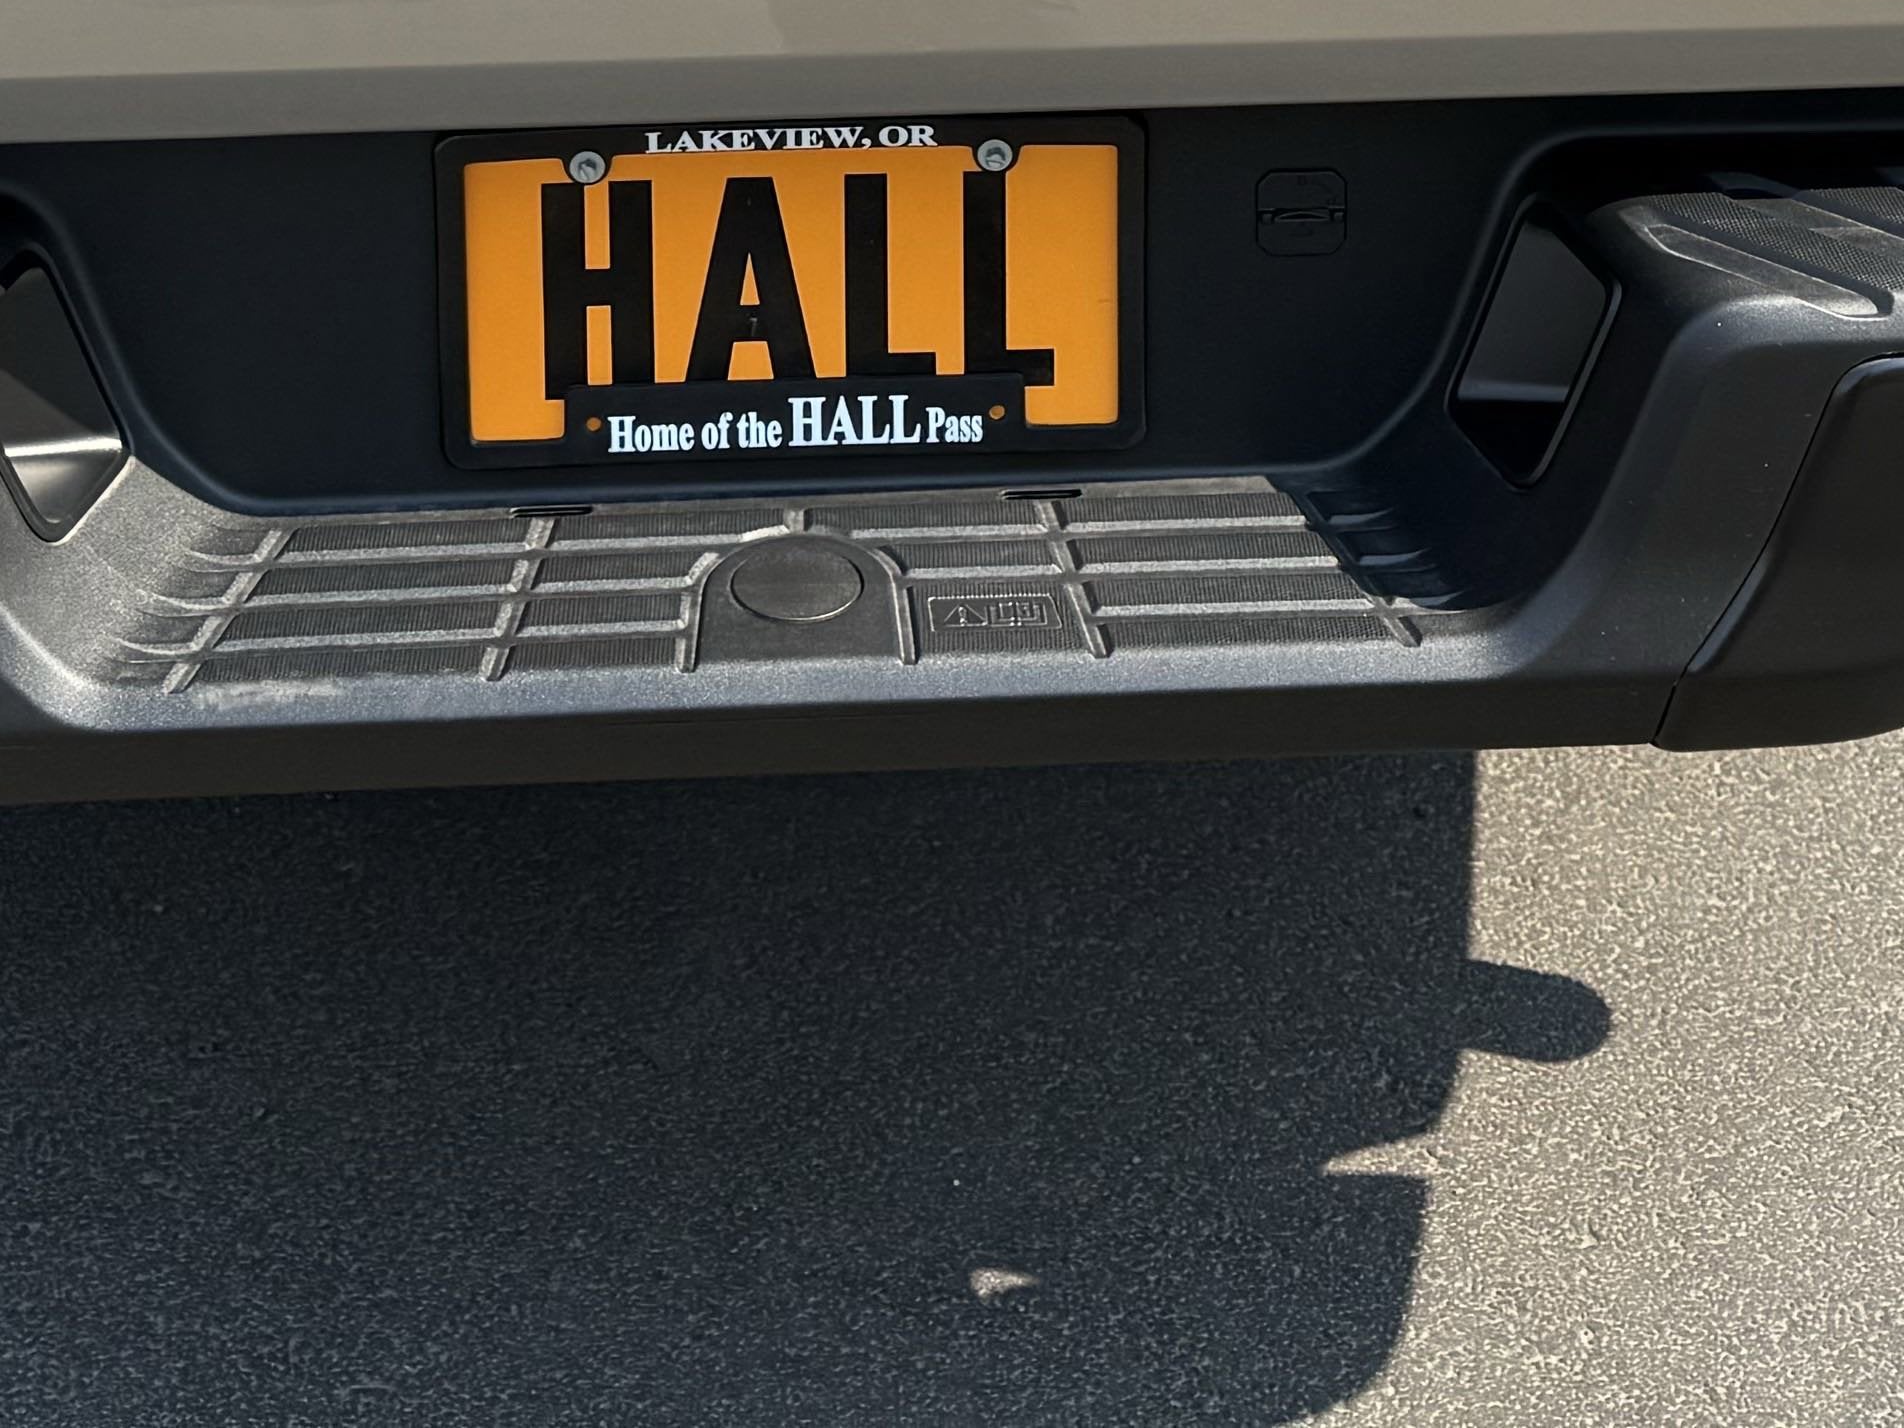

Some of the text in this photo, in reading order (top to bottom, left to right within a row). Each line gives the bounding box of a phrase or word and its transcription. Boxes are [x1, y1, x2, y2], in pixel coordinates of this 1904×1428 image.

[645, 125, 939, 154] LAKEVIEW, OR
[540, 171, 1055, 400] HALL
[607, 394, 984, 453] Home of the HALL Pass
